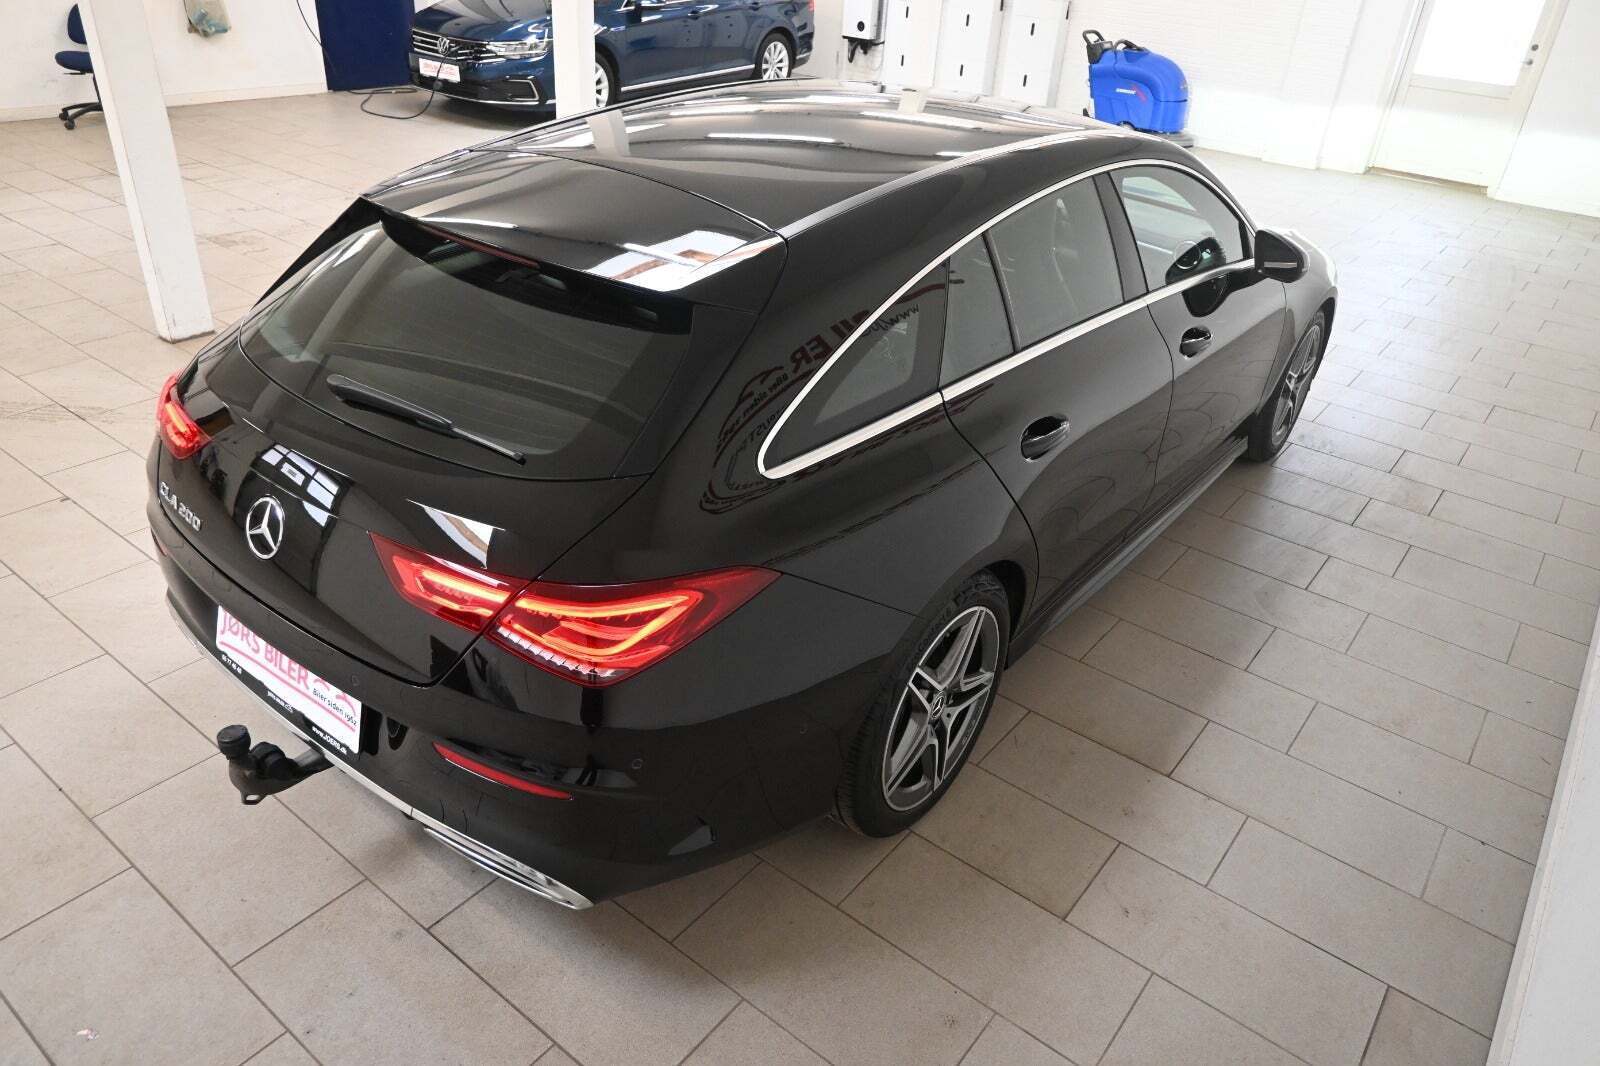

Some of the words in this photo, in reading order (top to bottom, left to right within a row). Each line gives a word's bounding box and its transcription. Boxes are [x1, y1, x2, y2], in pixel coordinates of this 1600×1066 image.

[160, 481, 177, 510] CLA
[177, 502, 201, 531] 200
[220, 608, 260, 654] JØRS
[264, 642, 310, 690] BILER
[312, 687, 328, 703] Biler
[327, 697, 344, 716] siden
